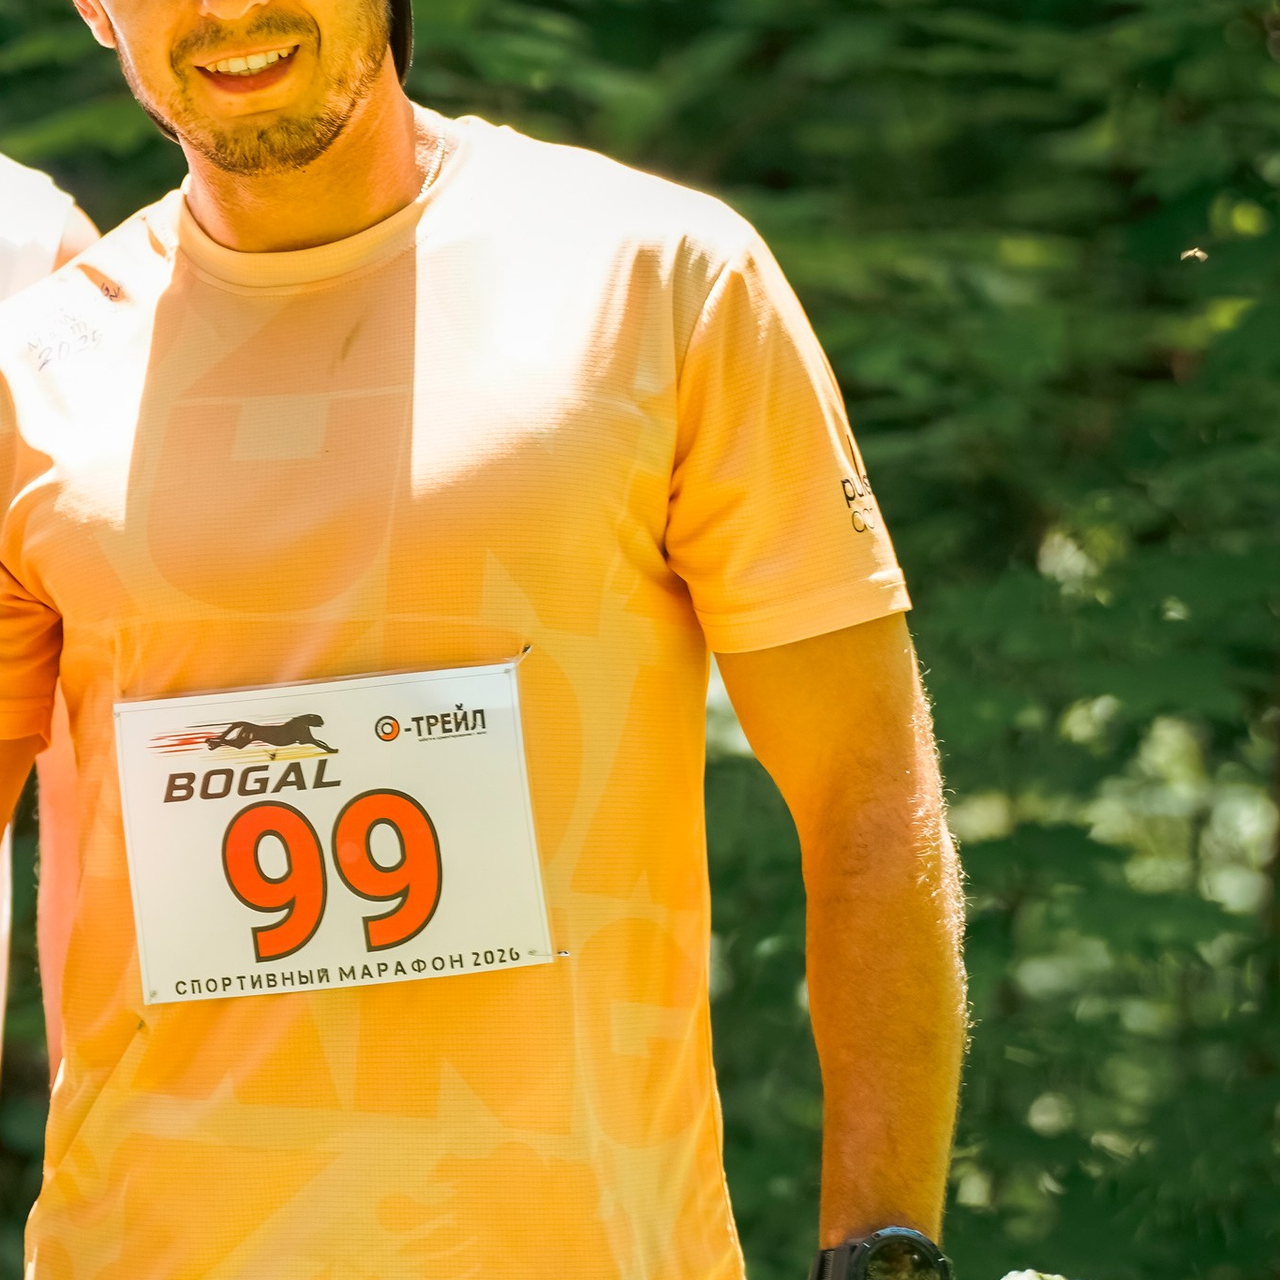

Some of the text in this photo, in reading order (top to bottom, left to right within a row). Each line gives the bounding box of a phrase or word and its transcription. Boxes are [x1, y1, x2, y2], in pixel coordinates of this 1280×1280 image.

[163, 758, 341, 803] BOGAL
[221, 787, 443, 963] 99
[175, 947, 521, 996] СПОРТИВНЫЙ МАРАФОН 2026
